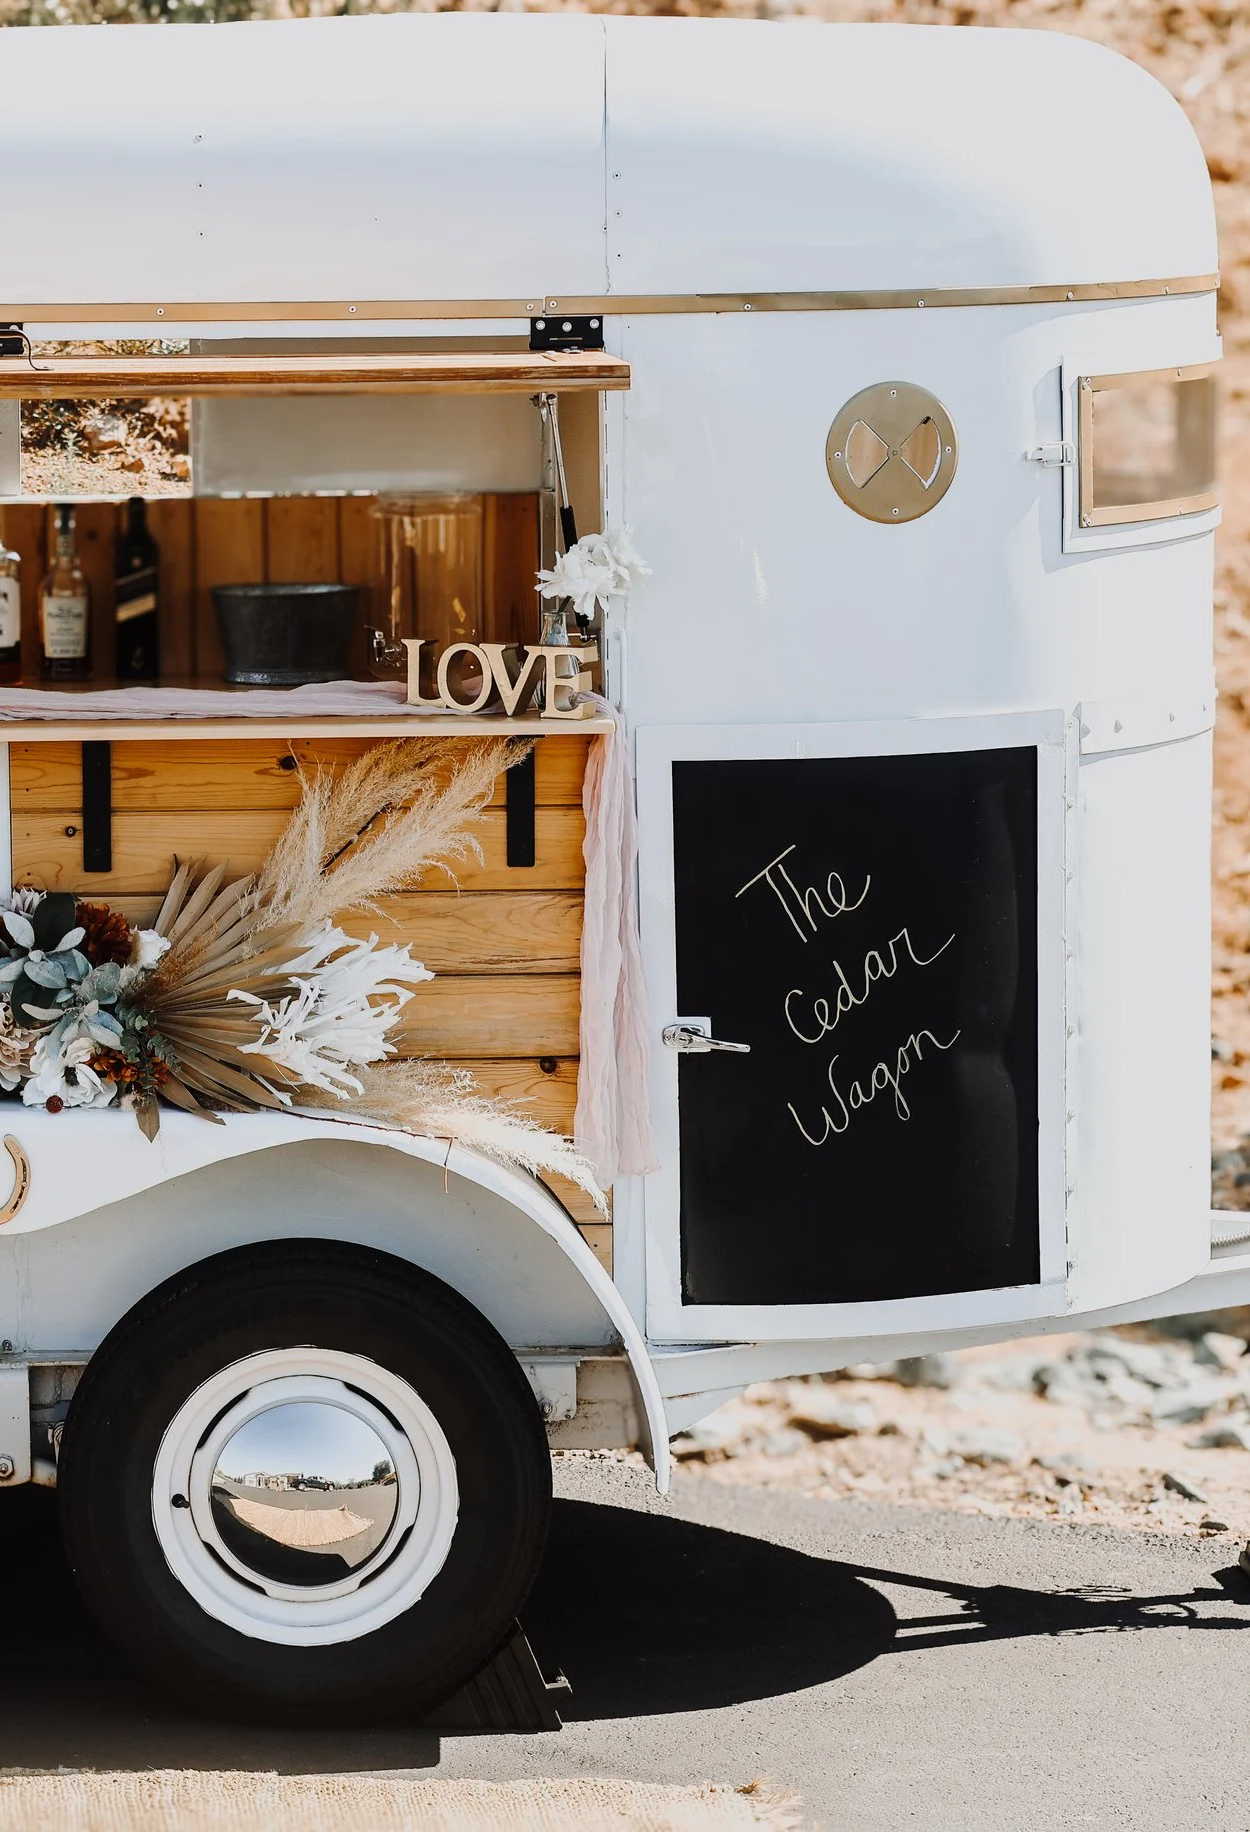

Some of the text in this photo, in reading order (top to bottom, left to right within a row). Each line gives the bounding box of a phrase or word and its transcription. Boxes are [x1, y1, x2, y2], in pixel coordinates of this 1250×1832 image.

[400, 638, 599, 721] LOVE
[734, 844, 871, 943] The
[784, 927, 956, 1044] Cedar
[787, 1029, 961, 1146] Wagon
